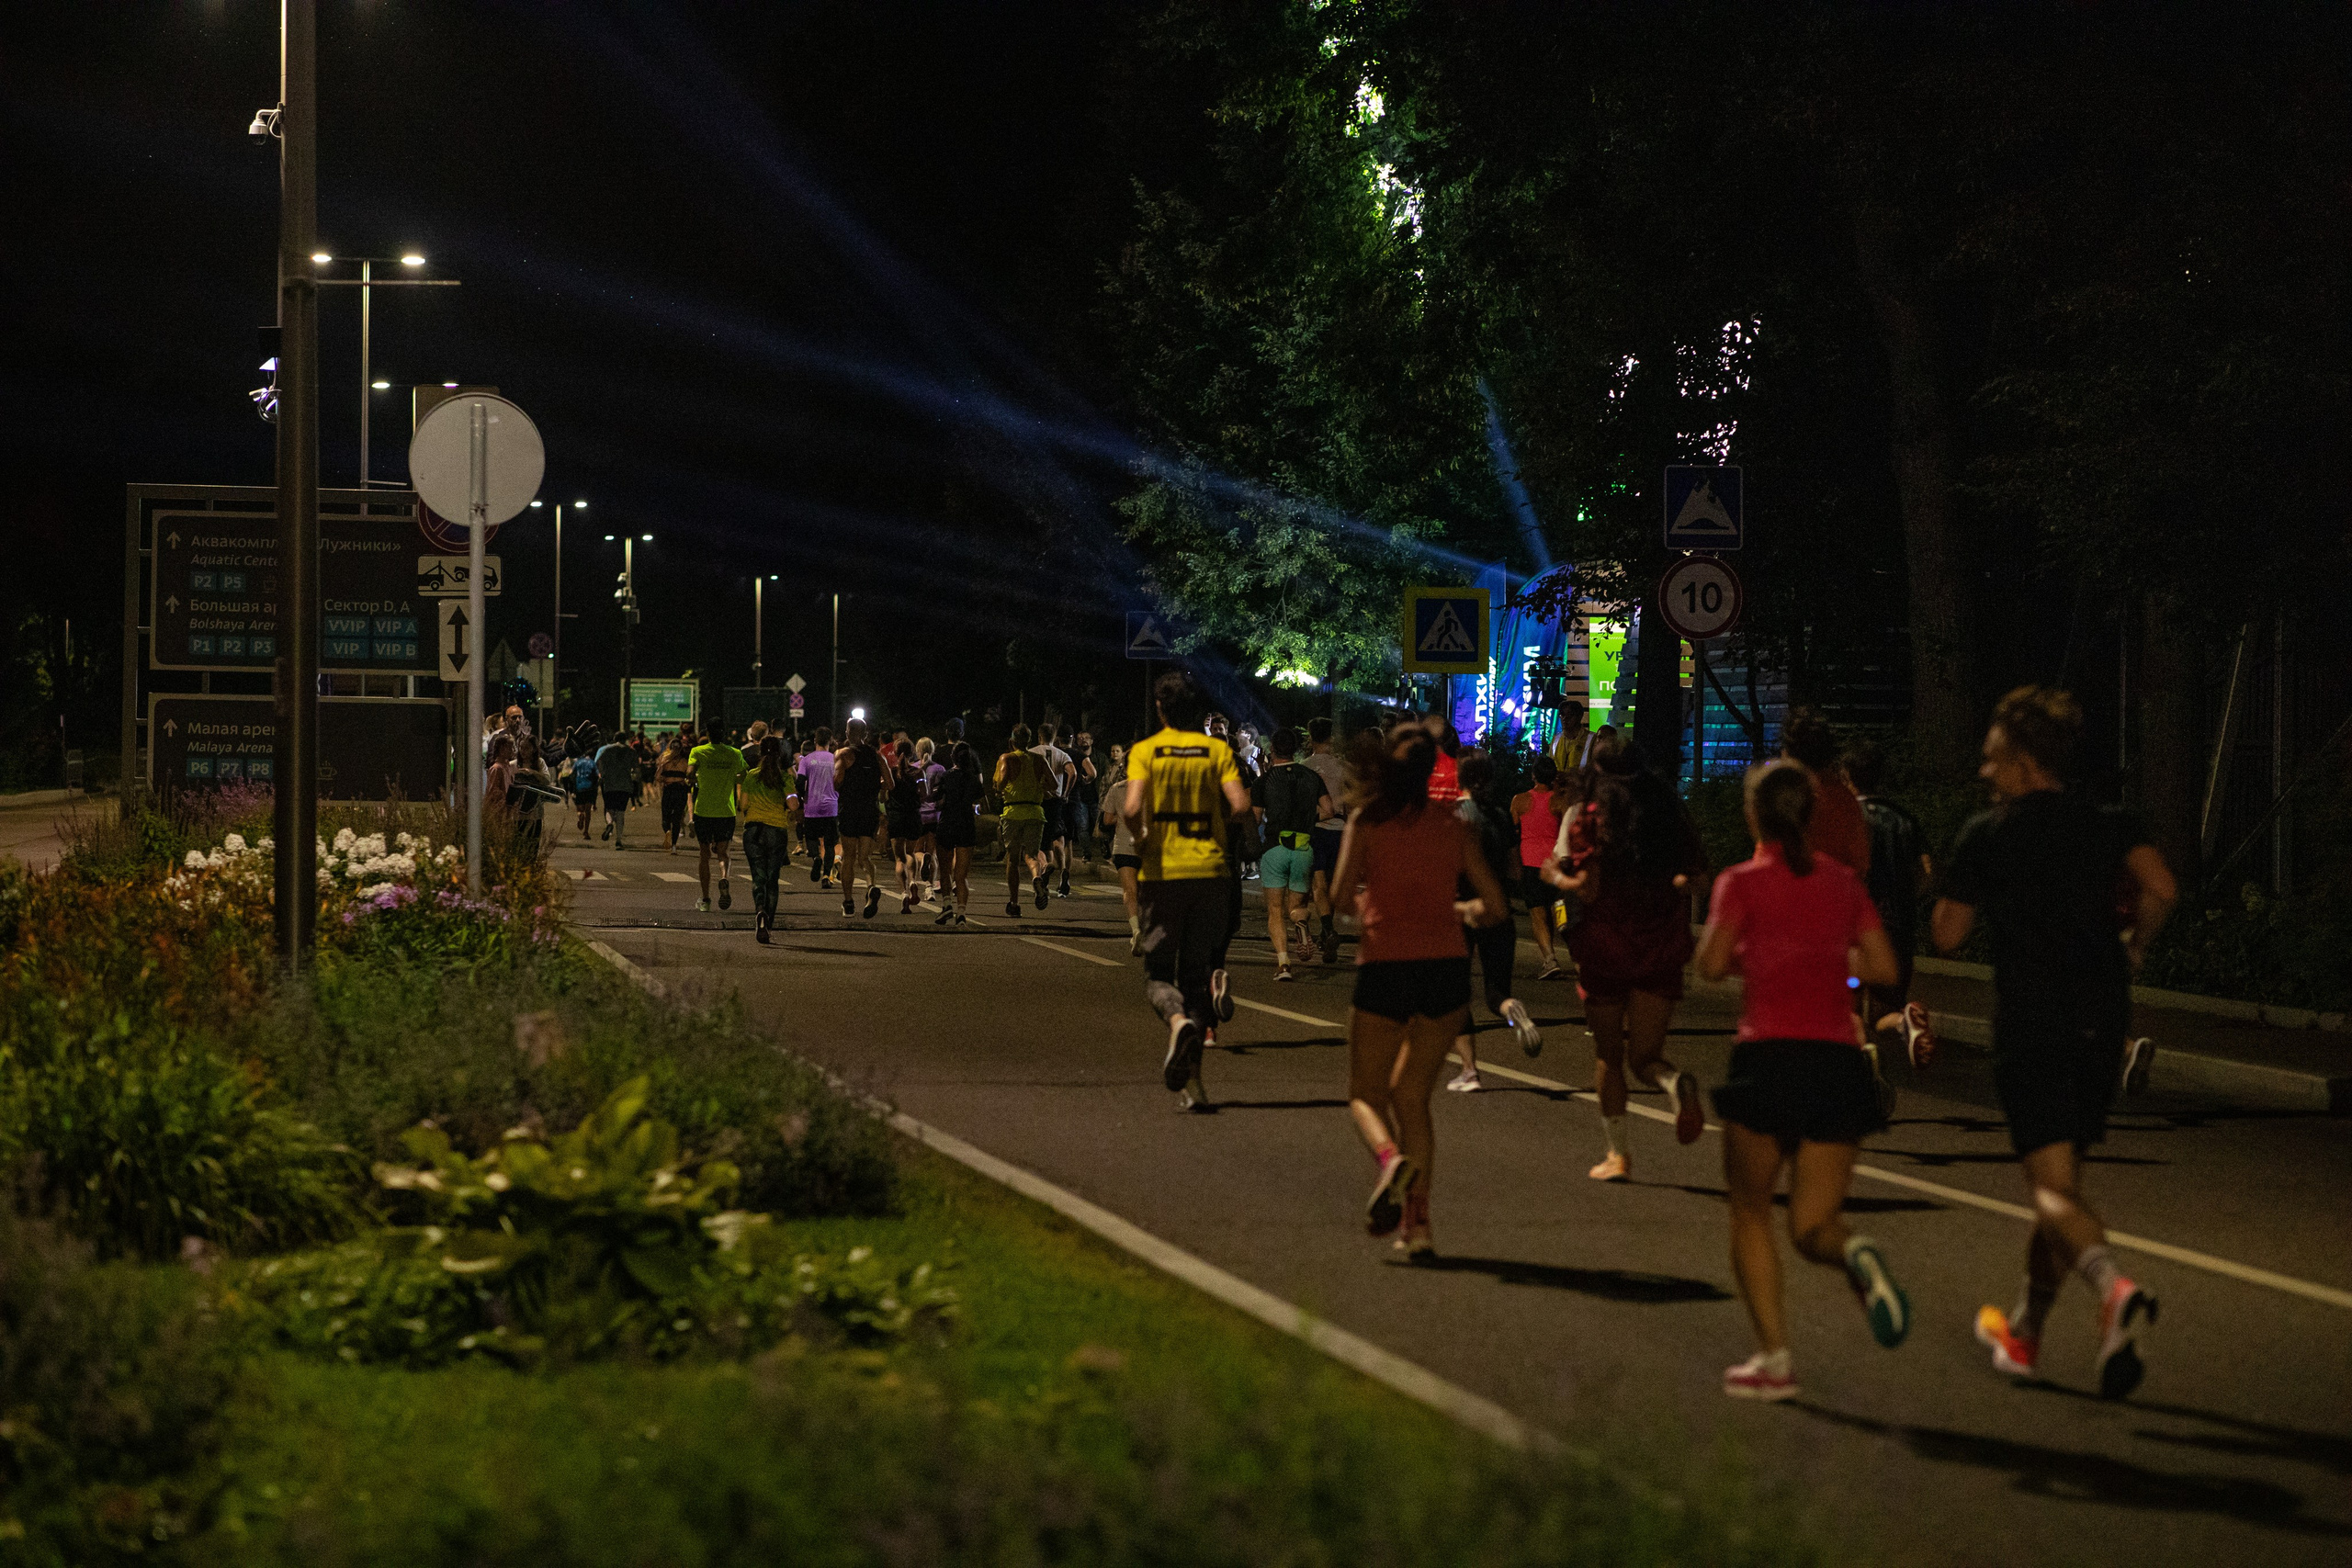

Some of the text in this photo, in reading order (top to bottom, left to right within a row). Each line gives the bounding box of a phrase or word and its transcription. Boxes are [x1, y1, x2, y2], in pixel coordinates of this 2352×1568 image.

[318, 537, 401, 553] Лужники»
[190, 554, 241, 568] Aquatic
[194, 575, 242, 588] P2 P5
[1681, 581, 1723, 614] 10
[190, 599, 259, 614] Большая
[324, 599, 379, 615] Сектор
[384, 601, 396, 615] D,
[189, 617, 245, 632] Bolshaya
[328, 620, 417, 634] VVIP VIP A
[193, 639, 272, 653] P1 P2 P3
[333, 643, 416, 656] VIP VIP B
[187, 722, 239, 735] Малая
[187, 741, 273, 755] Malaya Arena
[191, 761, 269, 775] P6 P7 P8
